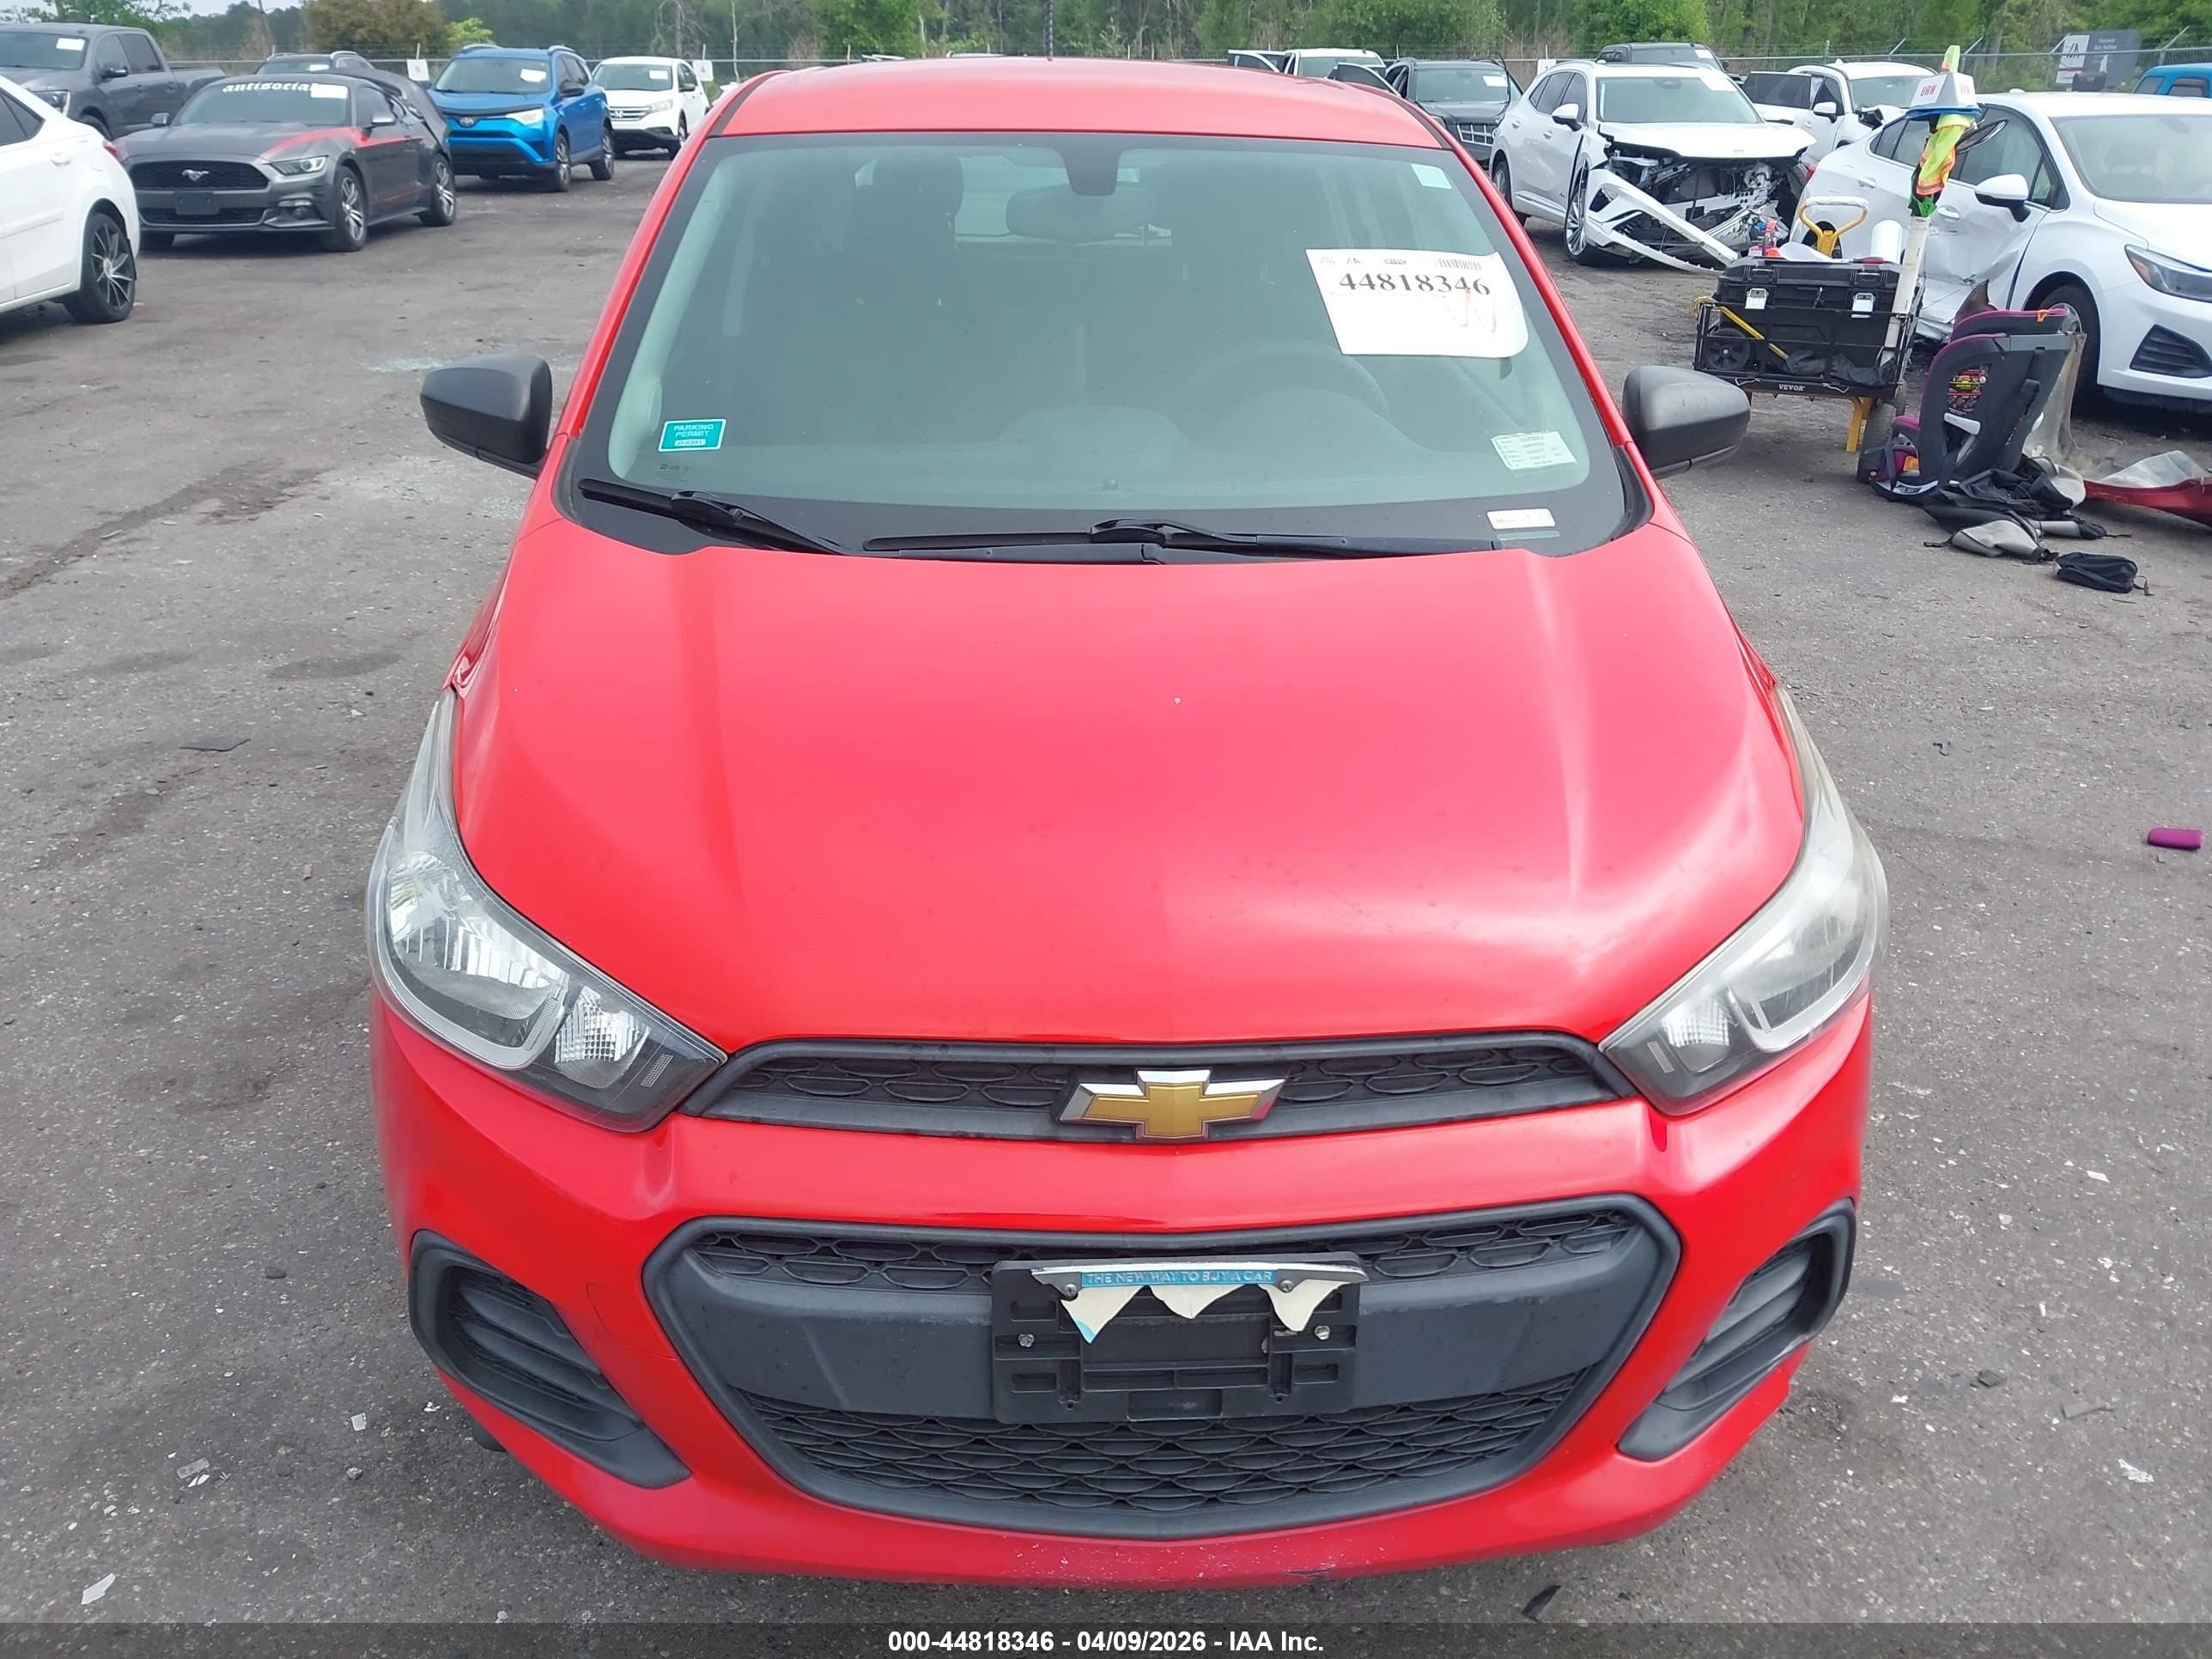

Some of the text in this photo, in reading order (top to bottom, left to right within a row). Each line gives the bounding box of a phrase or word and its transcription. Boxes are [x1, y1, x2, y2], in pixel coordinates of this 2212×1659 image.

[1340, 273, 1491, 295] 44818346
[1778, 383, 1806, 392] VEVOR
[673, 423, 714, 432] PARKING
[675, 430, 710, 439] PERMIT
[1085, 1270, 1273, 1284] THE NEW WAY TO BUY A CAR
